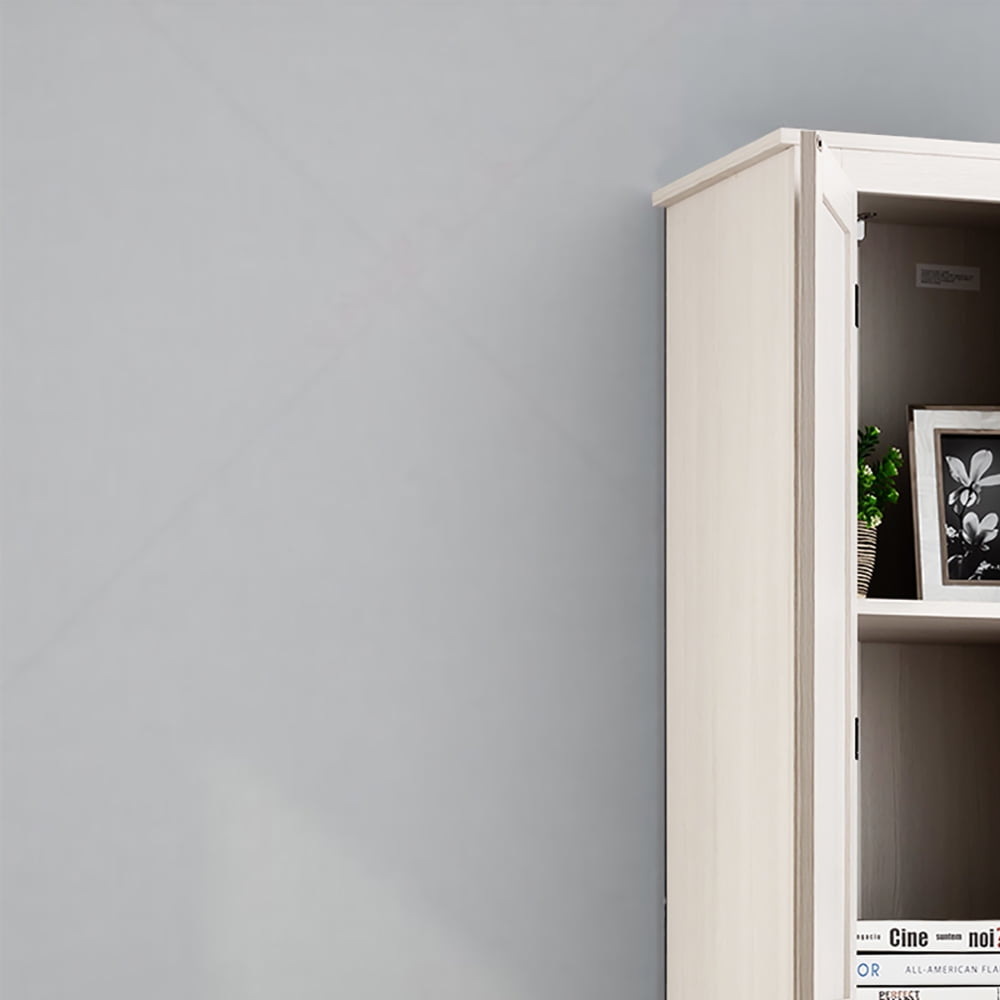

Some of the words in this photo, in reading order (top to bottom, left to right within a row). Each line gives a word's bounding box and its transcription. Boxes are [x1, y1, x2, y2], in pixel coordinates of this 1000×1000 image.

[889, 928, 929, 947] Cine
[856, 963, 880, 977] OR
[905, 965, 978, 974] ALL-AMERICAN
